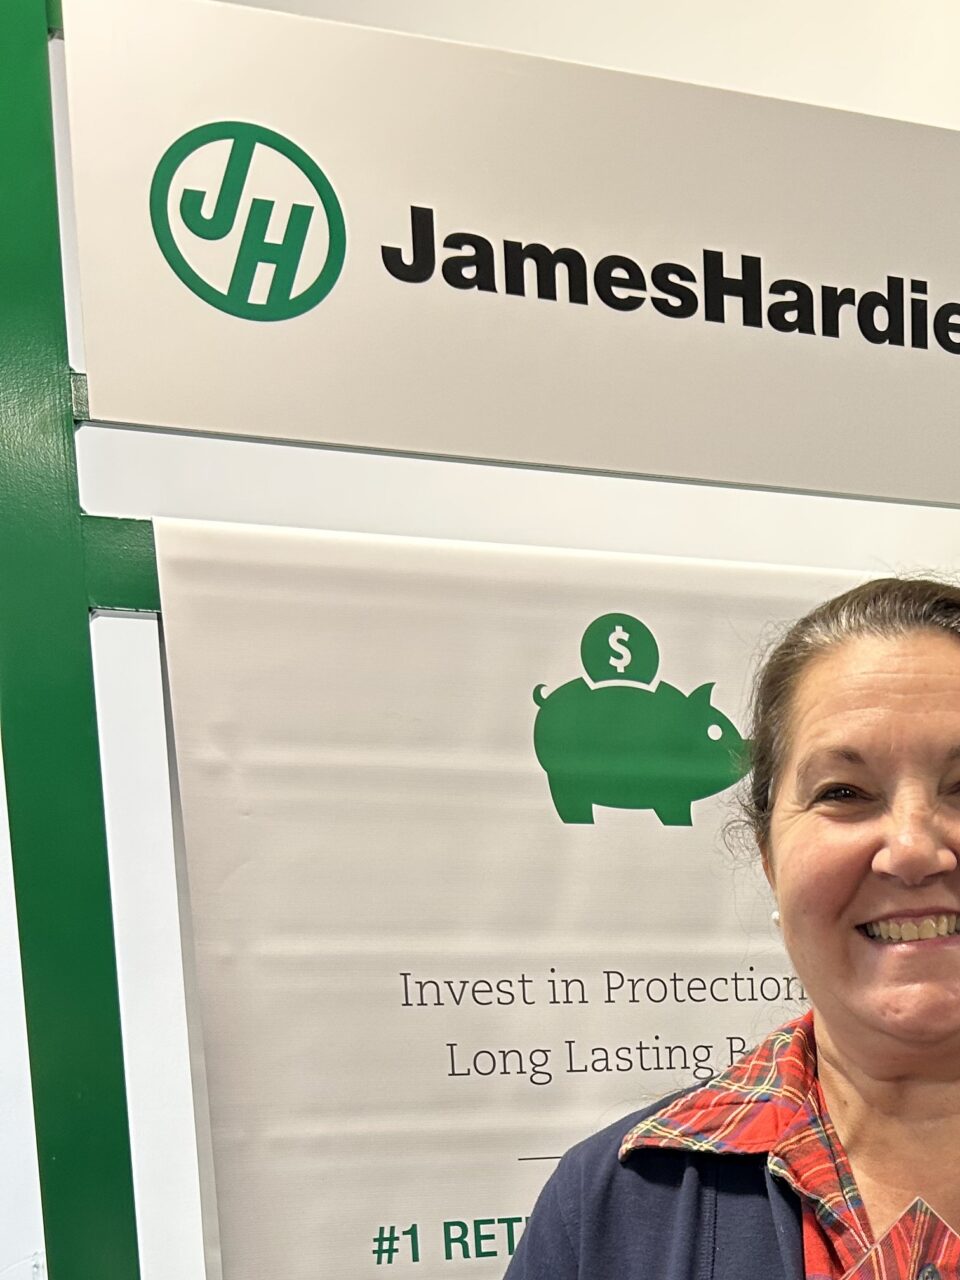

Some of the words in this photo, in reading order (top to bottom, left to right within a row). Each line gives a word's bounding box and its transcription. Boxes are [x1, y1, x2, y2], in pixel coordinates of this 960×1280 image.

[400, 972, 535, 1008] Invest
[548, 967, 589, 1006] in
[603, 966, 808, 1007] Protection
[447, 1041, 553, 1087] Long
[566, 1036, 715, 1081] Lasting
[372, 1224, 420, 1265] #1
[443, 1216, 531, 1260] RET
